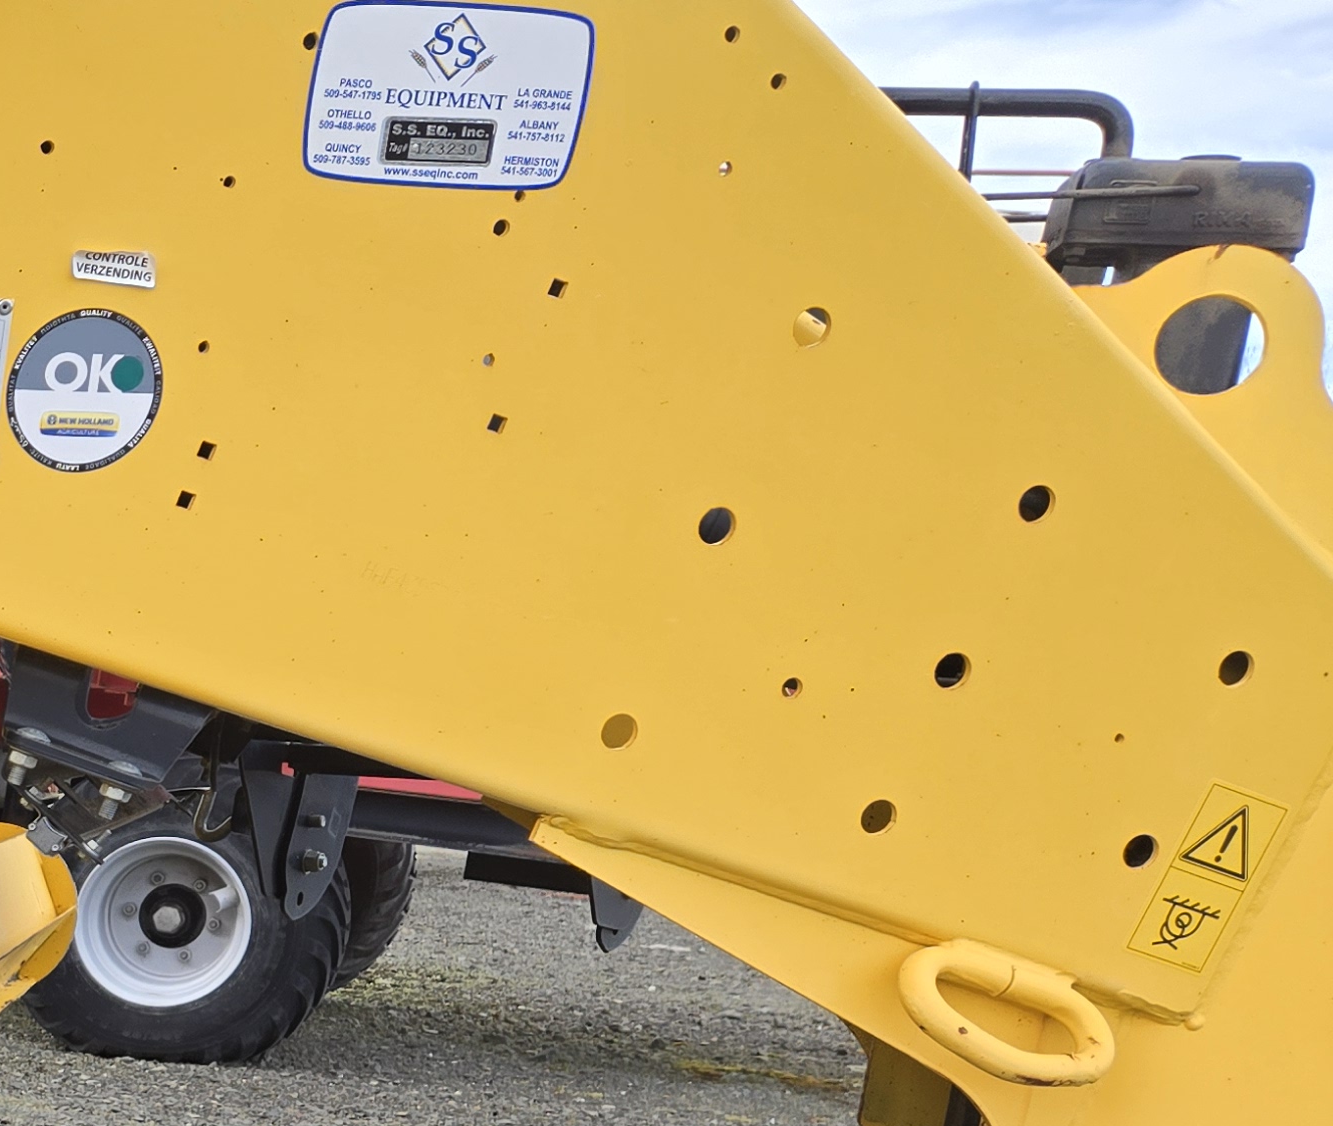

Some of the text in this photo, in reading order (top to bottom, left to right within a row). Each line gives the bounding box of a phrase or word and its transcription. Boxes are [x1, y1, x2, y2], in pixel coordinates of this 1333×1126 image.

[339, 78, 373, 88] PASCO
[324, 89, 382, 100] 509-547-1795
[385, 88, 508, 110] EQUIPMENT
[517, 88, 573, 100] LA GRANDE
[513, 99, 572, 111] 541-963-8144
[327, 109, 372, 120] OTHELLO
[391, 123, 421, 135] S.S.
[461, 126, 489, 138] Inc.
[519, 120, 559, 130] ALBANY
[507, 131, 565, 143] 541-757-8112
[325, 143, 362, 153] QUINCY
[414, 143, 477, 156] 123230
[313, 154, 371, 166] 509-787-3595
[504, 155, 560, 167] HERMISTON
[501, 166, 557, 178] 541-567-3001
[85, 251, 149, 268] CONTROLE
[76, 262, 153, 282] VERZENDING
[80, 310, 113, 318] QUALITY
[14, 335, 38, 369] KVALITET
[45, 351, 124, 393] OK
[78, 417, 114, 425] HOLLAND
[55, 462, 80, 471] LAATU
